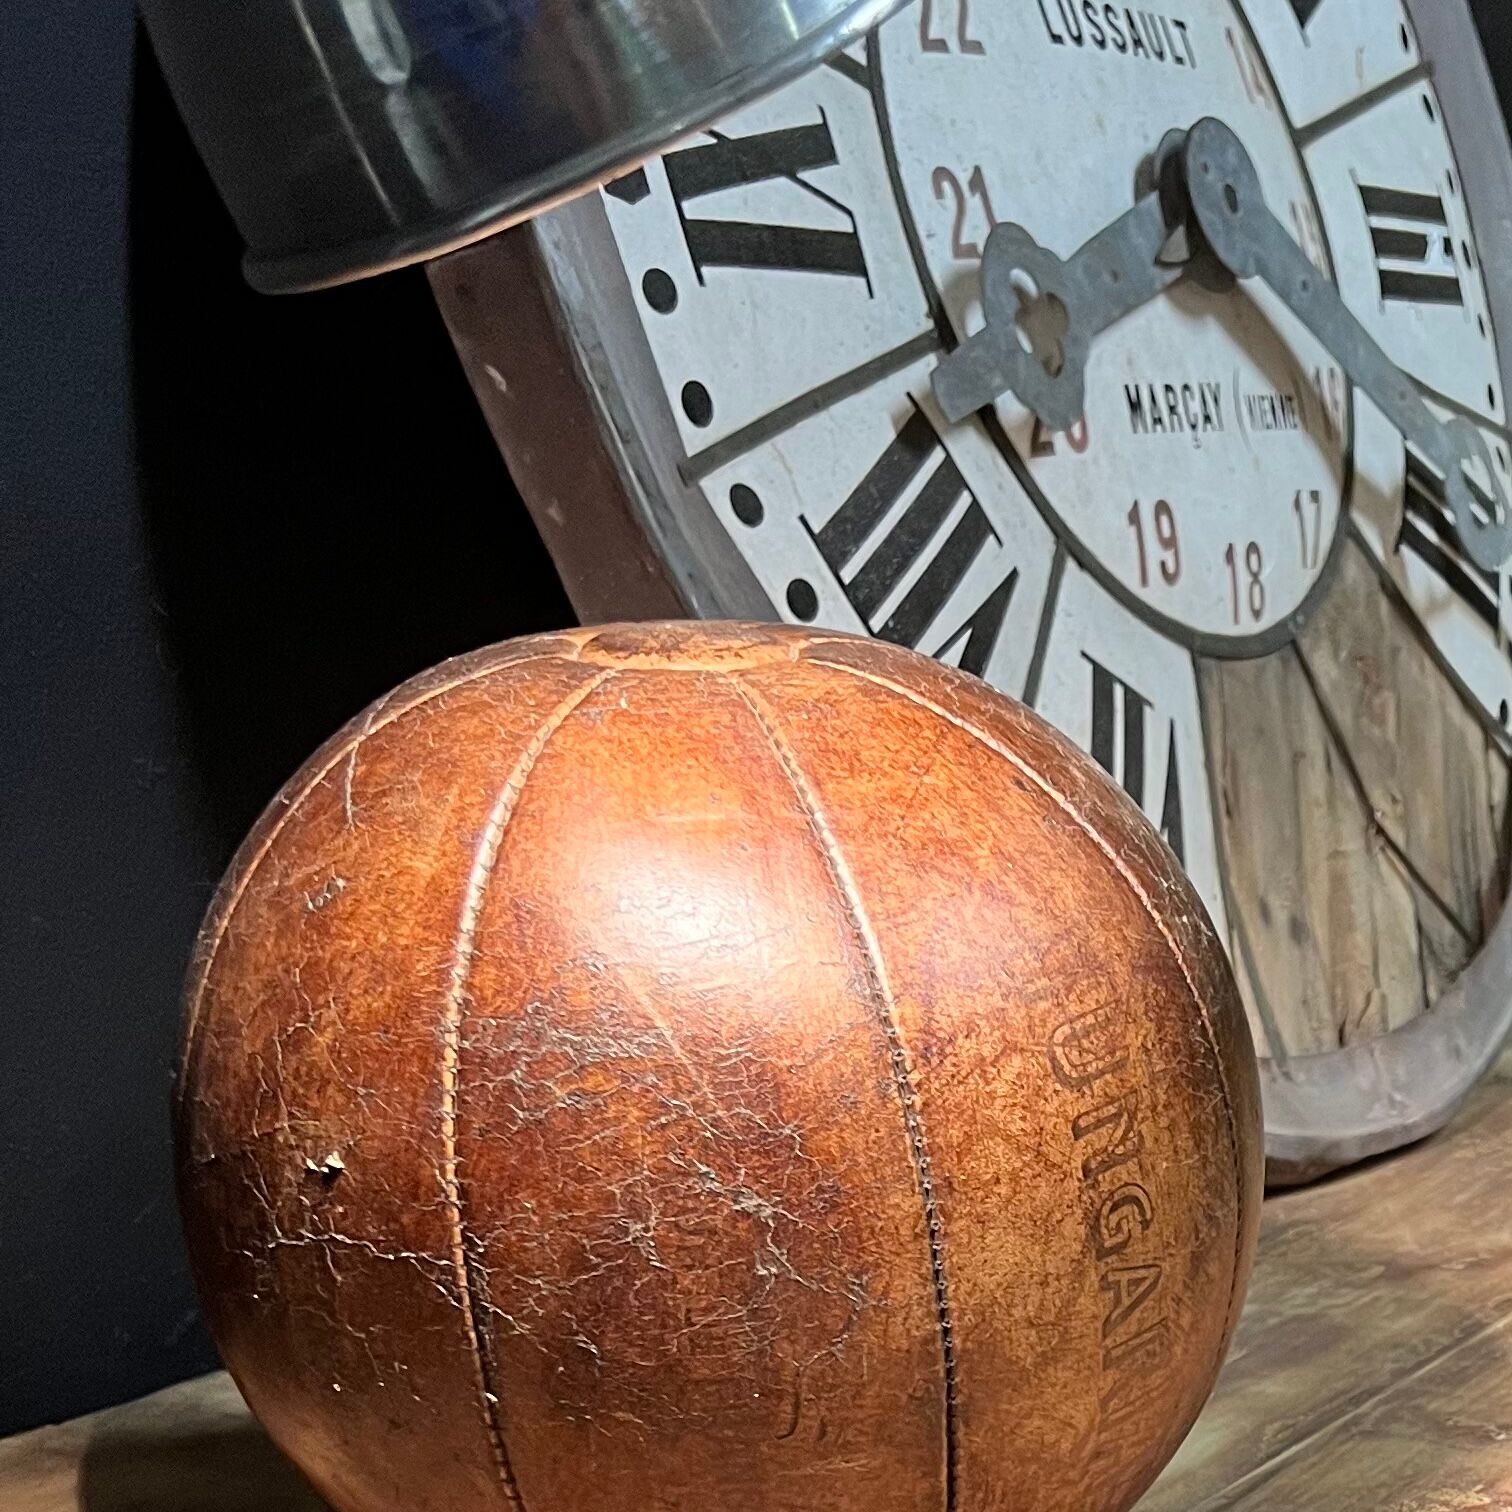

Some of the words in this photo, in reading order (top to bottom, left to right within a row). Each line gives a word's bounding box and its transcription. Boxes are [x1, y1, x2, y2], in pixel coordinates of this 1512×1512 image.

[1037, 0, 1197, 69] LUSSAULT
[1124, 382, 1225, 449] MARÇAY
[1128, 499, 1182, 587] 19
[1294, 489, 1321, 570] 17
[1225, 541, 1265, 626] 18
